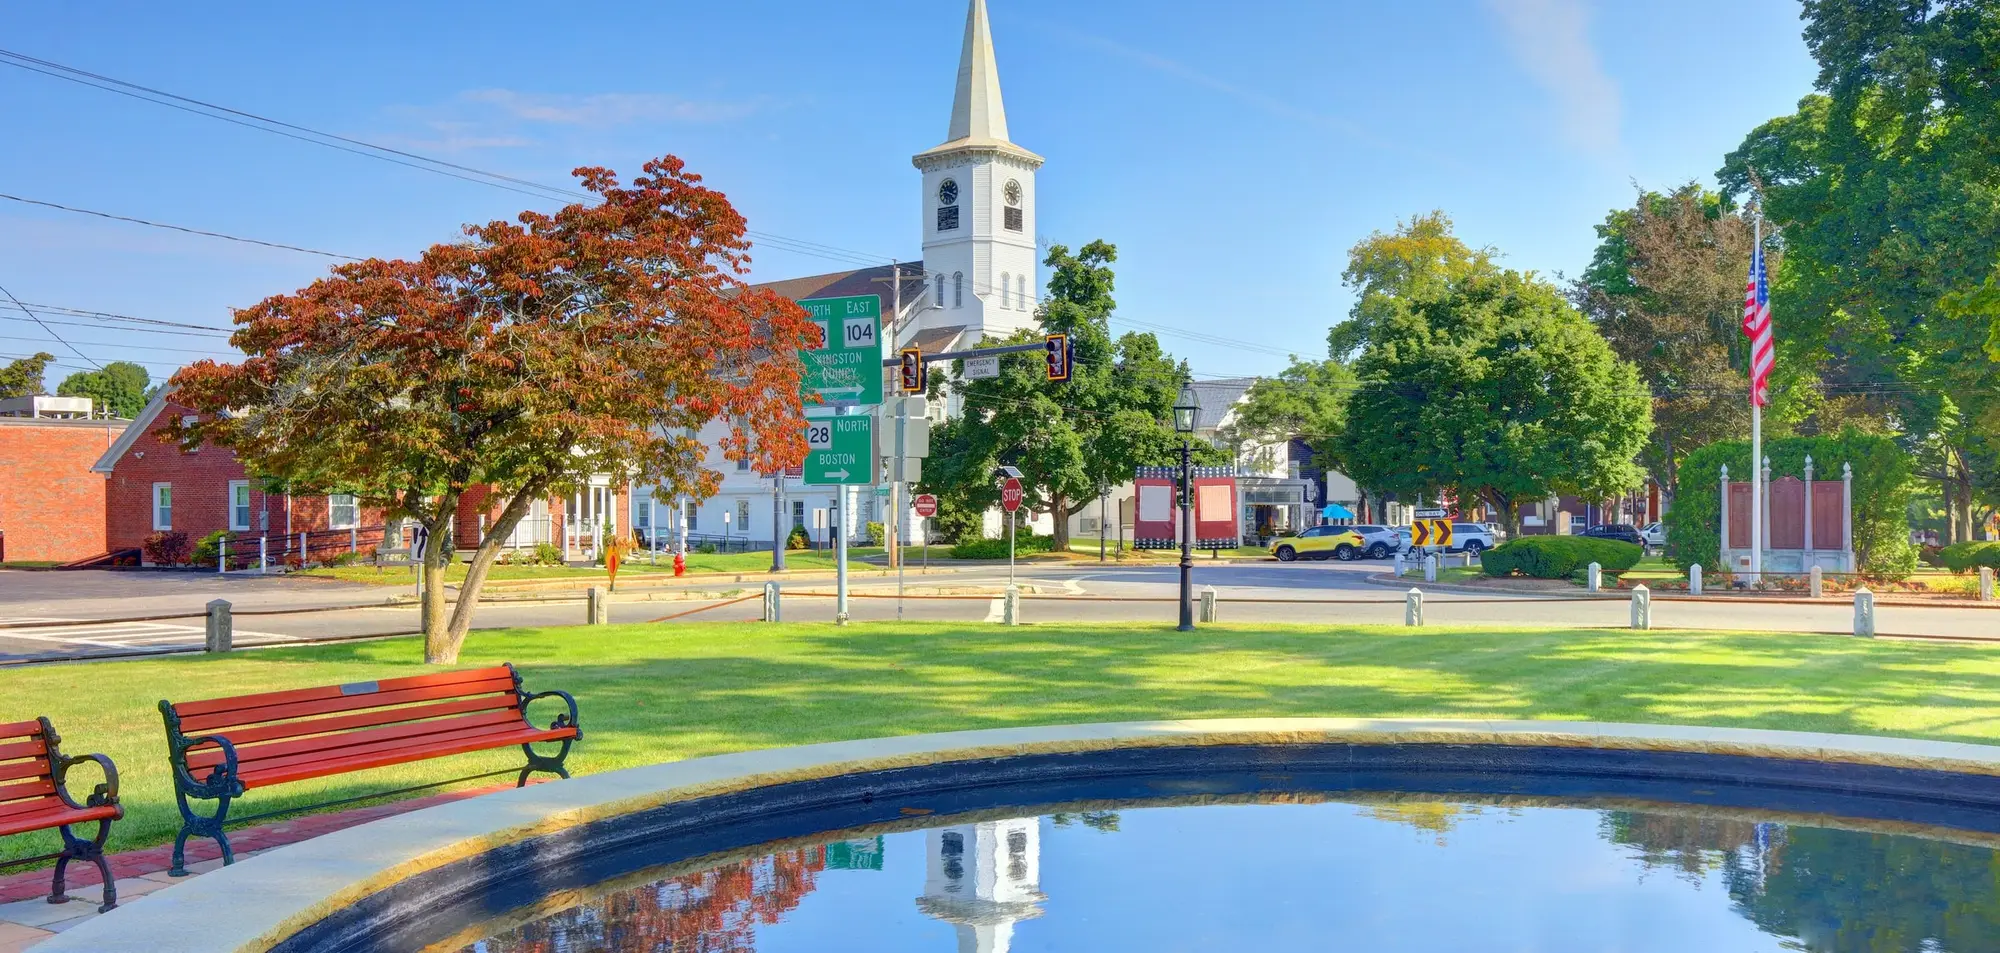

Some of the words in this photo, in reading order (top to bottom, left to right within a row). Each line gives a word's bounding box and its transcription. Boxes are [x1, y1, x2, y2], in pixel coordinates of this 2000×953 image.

[846, 301, 870, 314] EAST
[846, 324, 872, 340] 104
[817, 352, 862, 365] KINGSTON
[966, 360, 994, 368] EMERGENCY
[810, 427, 829, 443] 28
[836, 420, 868, 432] NORTH
[820, 454, 856, 464] BOSTON
[1004, 488, 1020, 501] STOP
